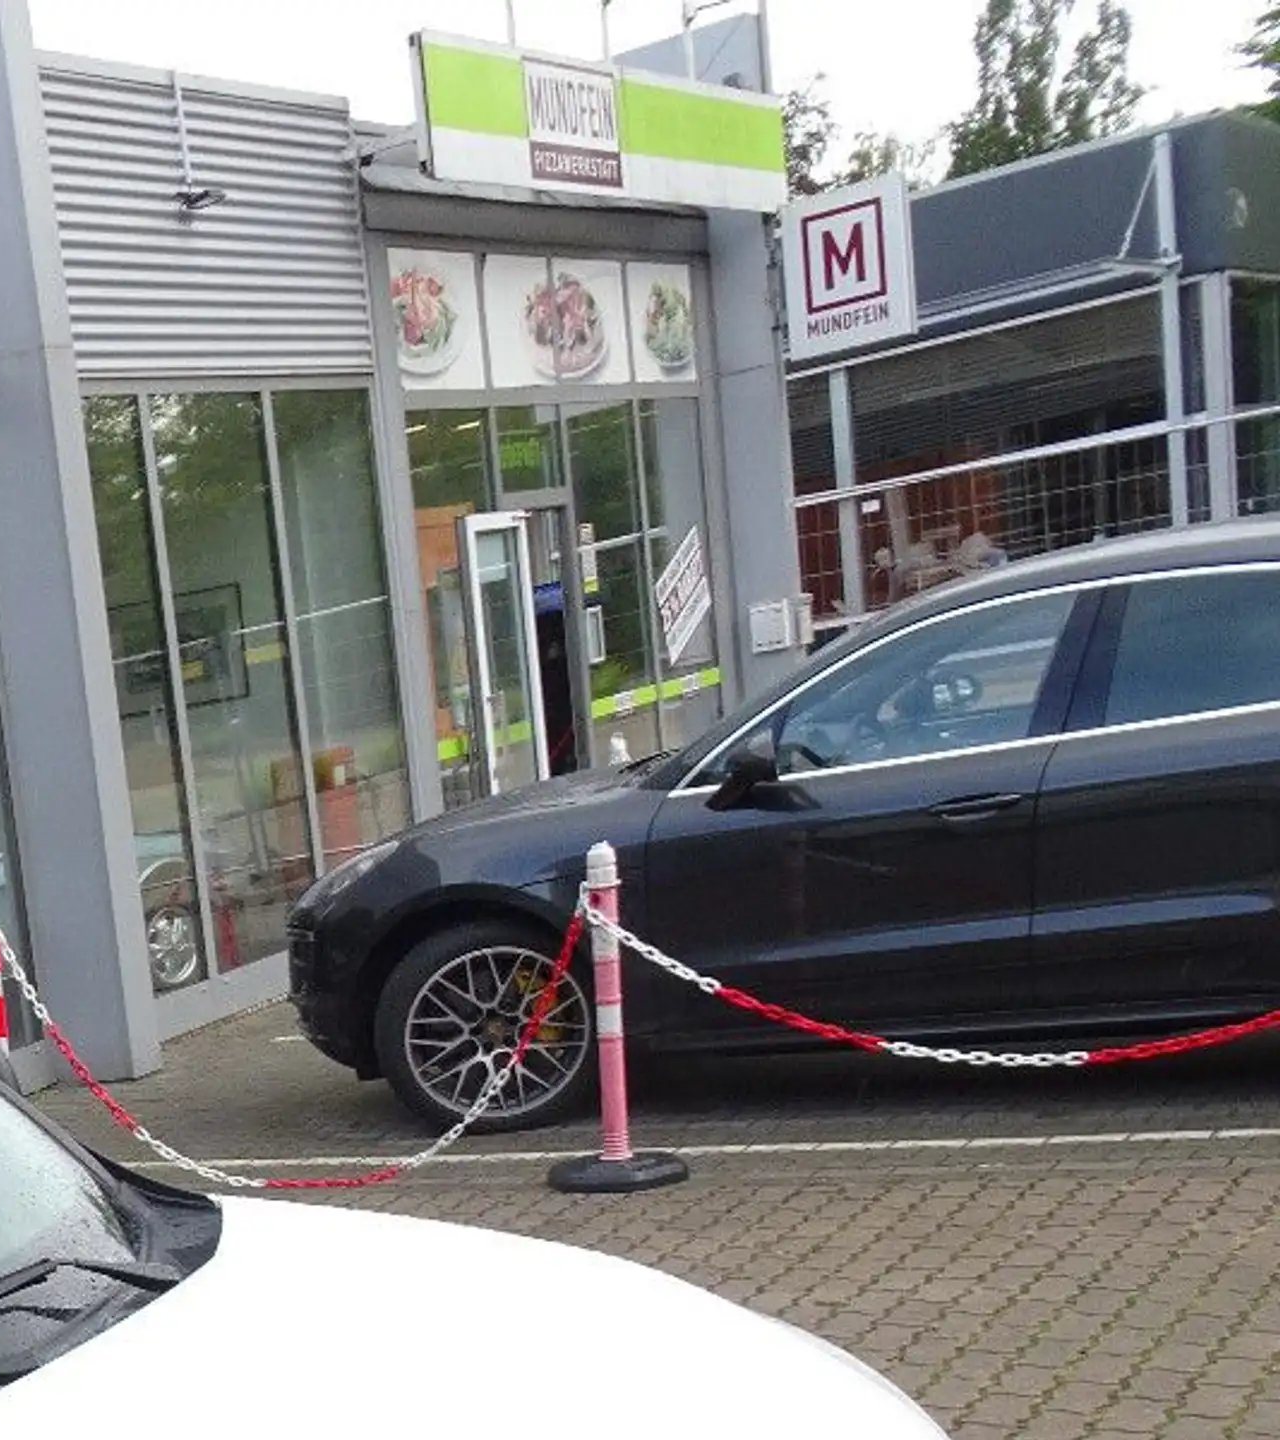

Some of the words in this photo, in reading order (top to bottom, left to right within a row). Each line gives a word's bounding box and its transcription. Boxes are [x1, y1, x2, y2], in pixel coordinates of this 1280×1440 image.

[528, 74, 614, 141] MUNDFEIN
[822, 221, 866, 290] M
[806, 302, 890, 338] MUNDFEIN
